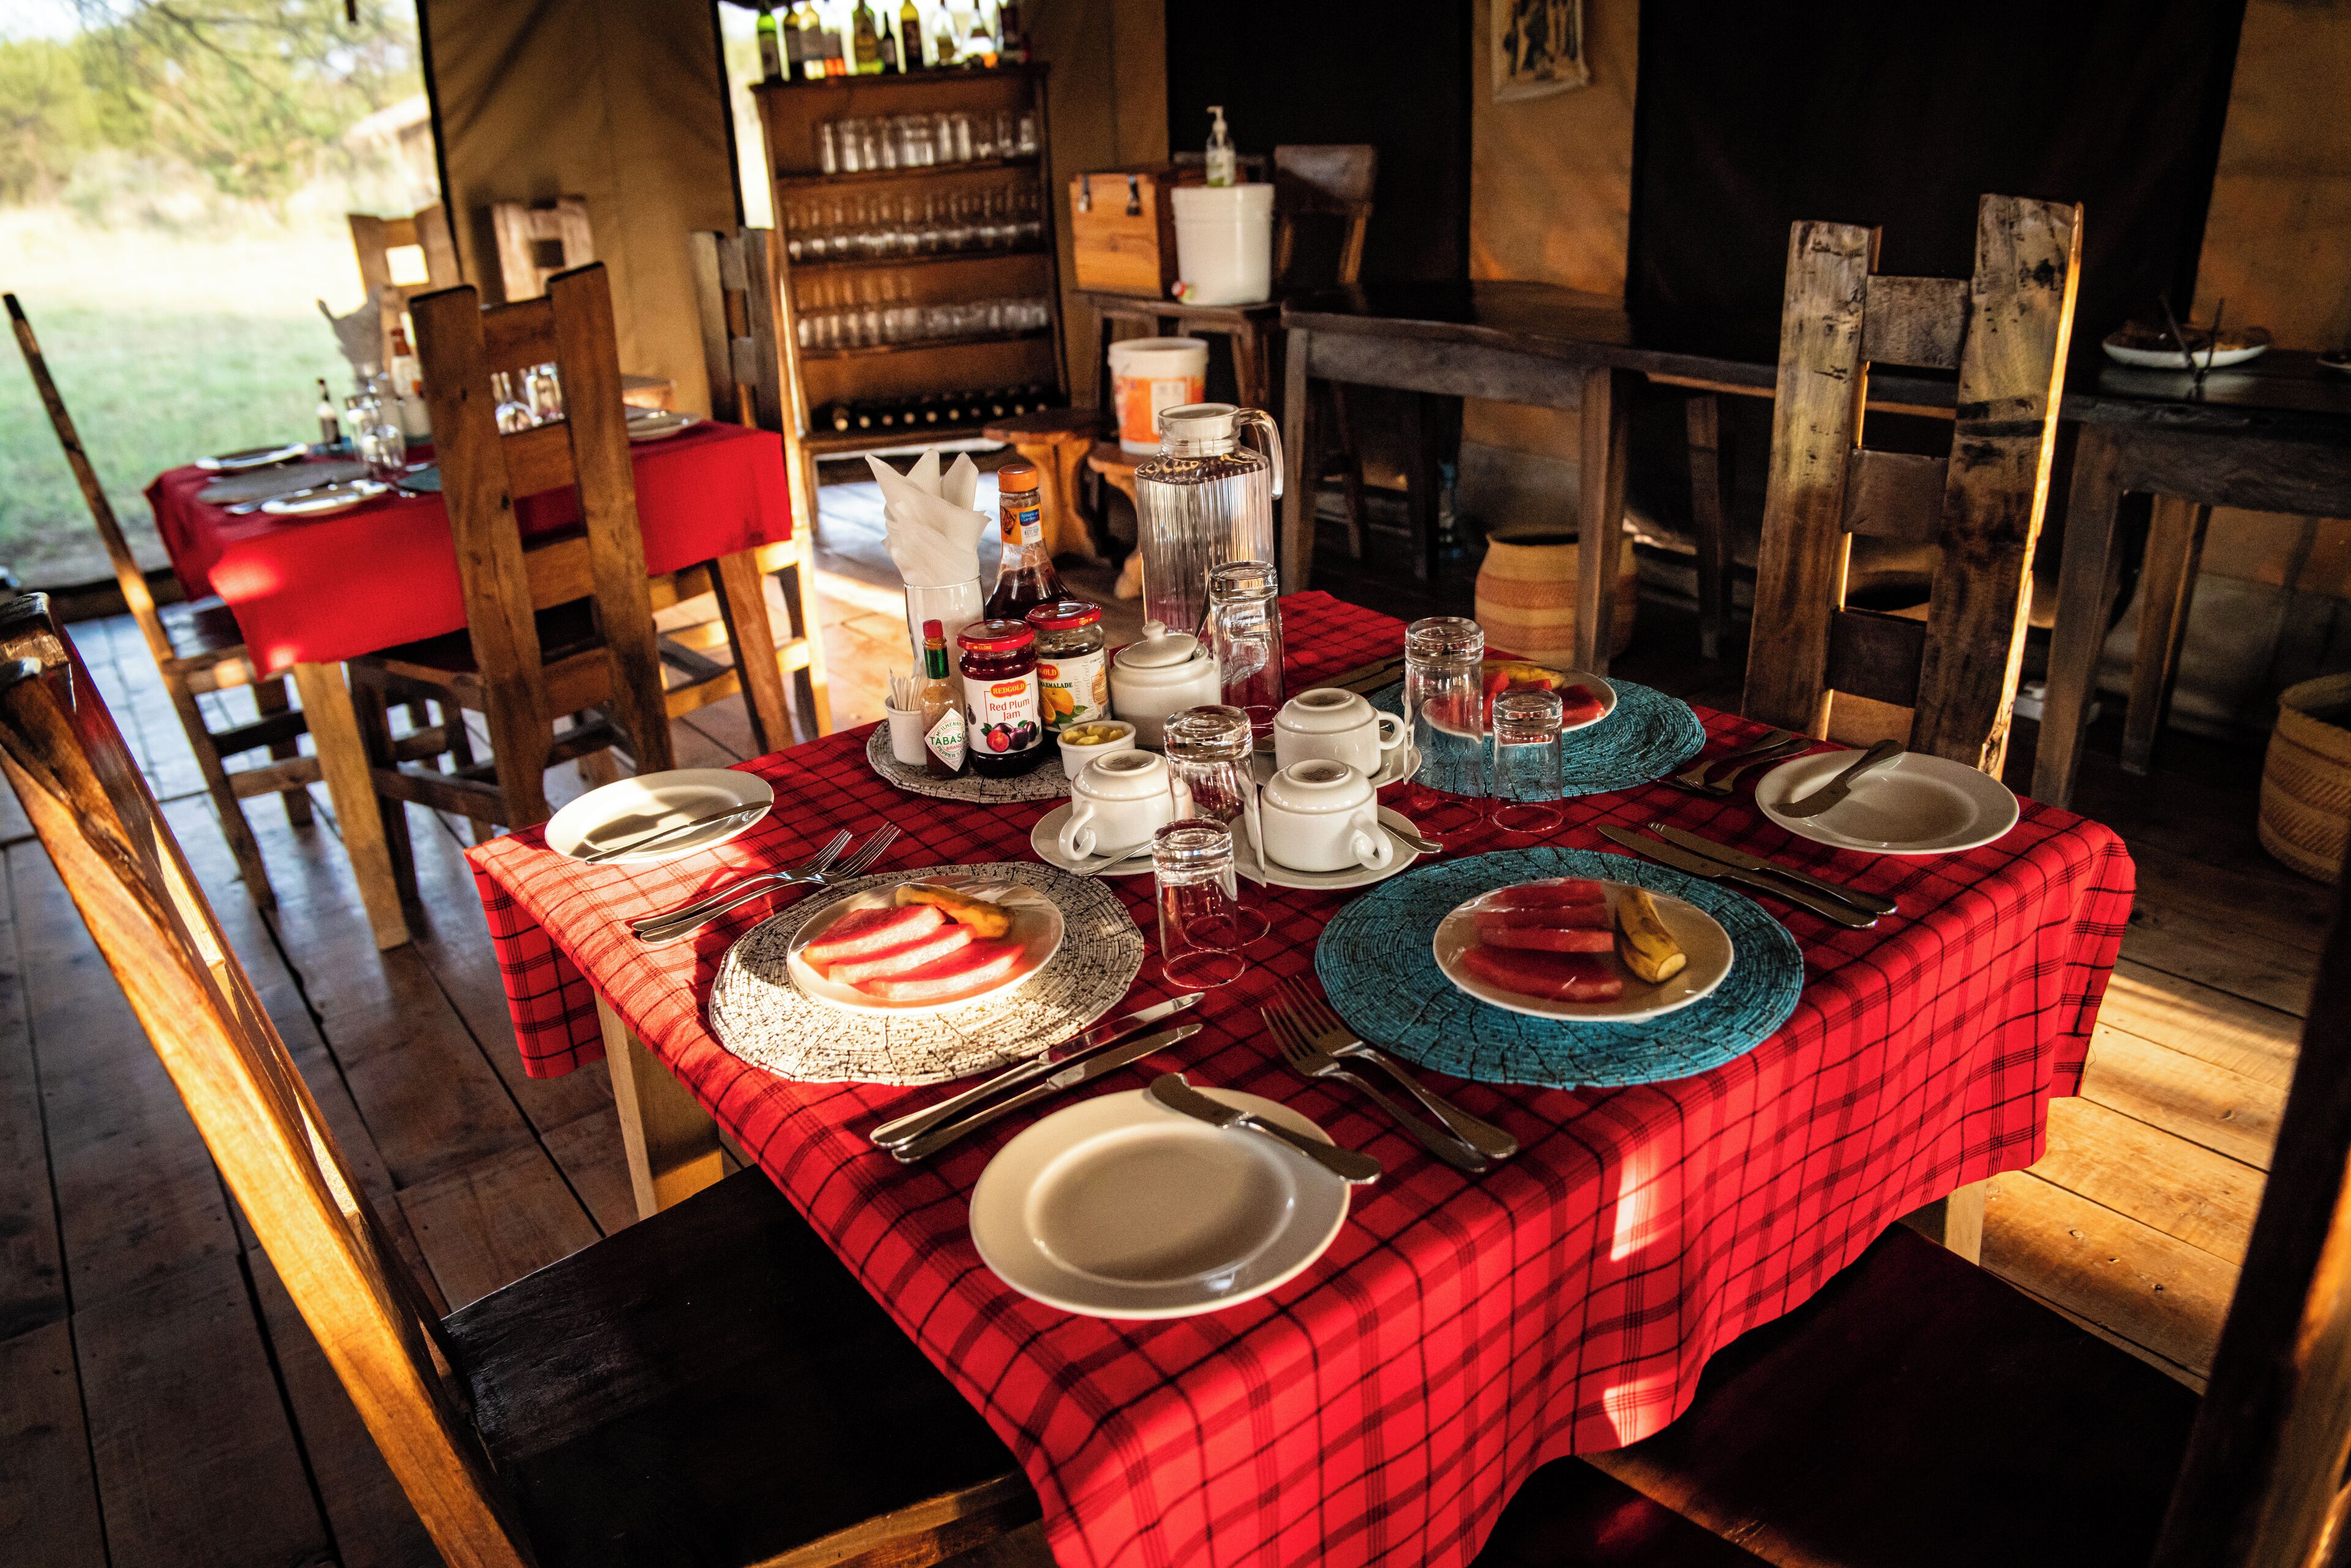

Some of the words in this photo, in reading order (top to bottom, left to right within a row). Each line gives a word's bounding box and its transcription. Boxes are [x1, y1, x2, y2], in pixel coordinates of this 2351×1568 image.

[1039, 668, 1057, 677] GOLD
[992, 683, 1025, 694] REDGOLD
[989, 702, 1007, 711] Red
[1010, 698, 1030, 710] Plum
[1003, 710, 1021, 721] Jam
[929, 730, 965, 746] TABASC
[937, 746, 956, 759] PEPPER
